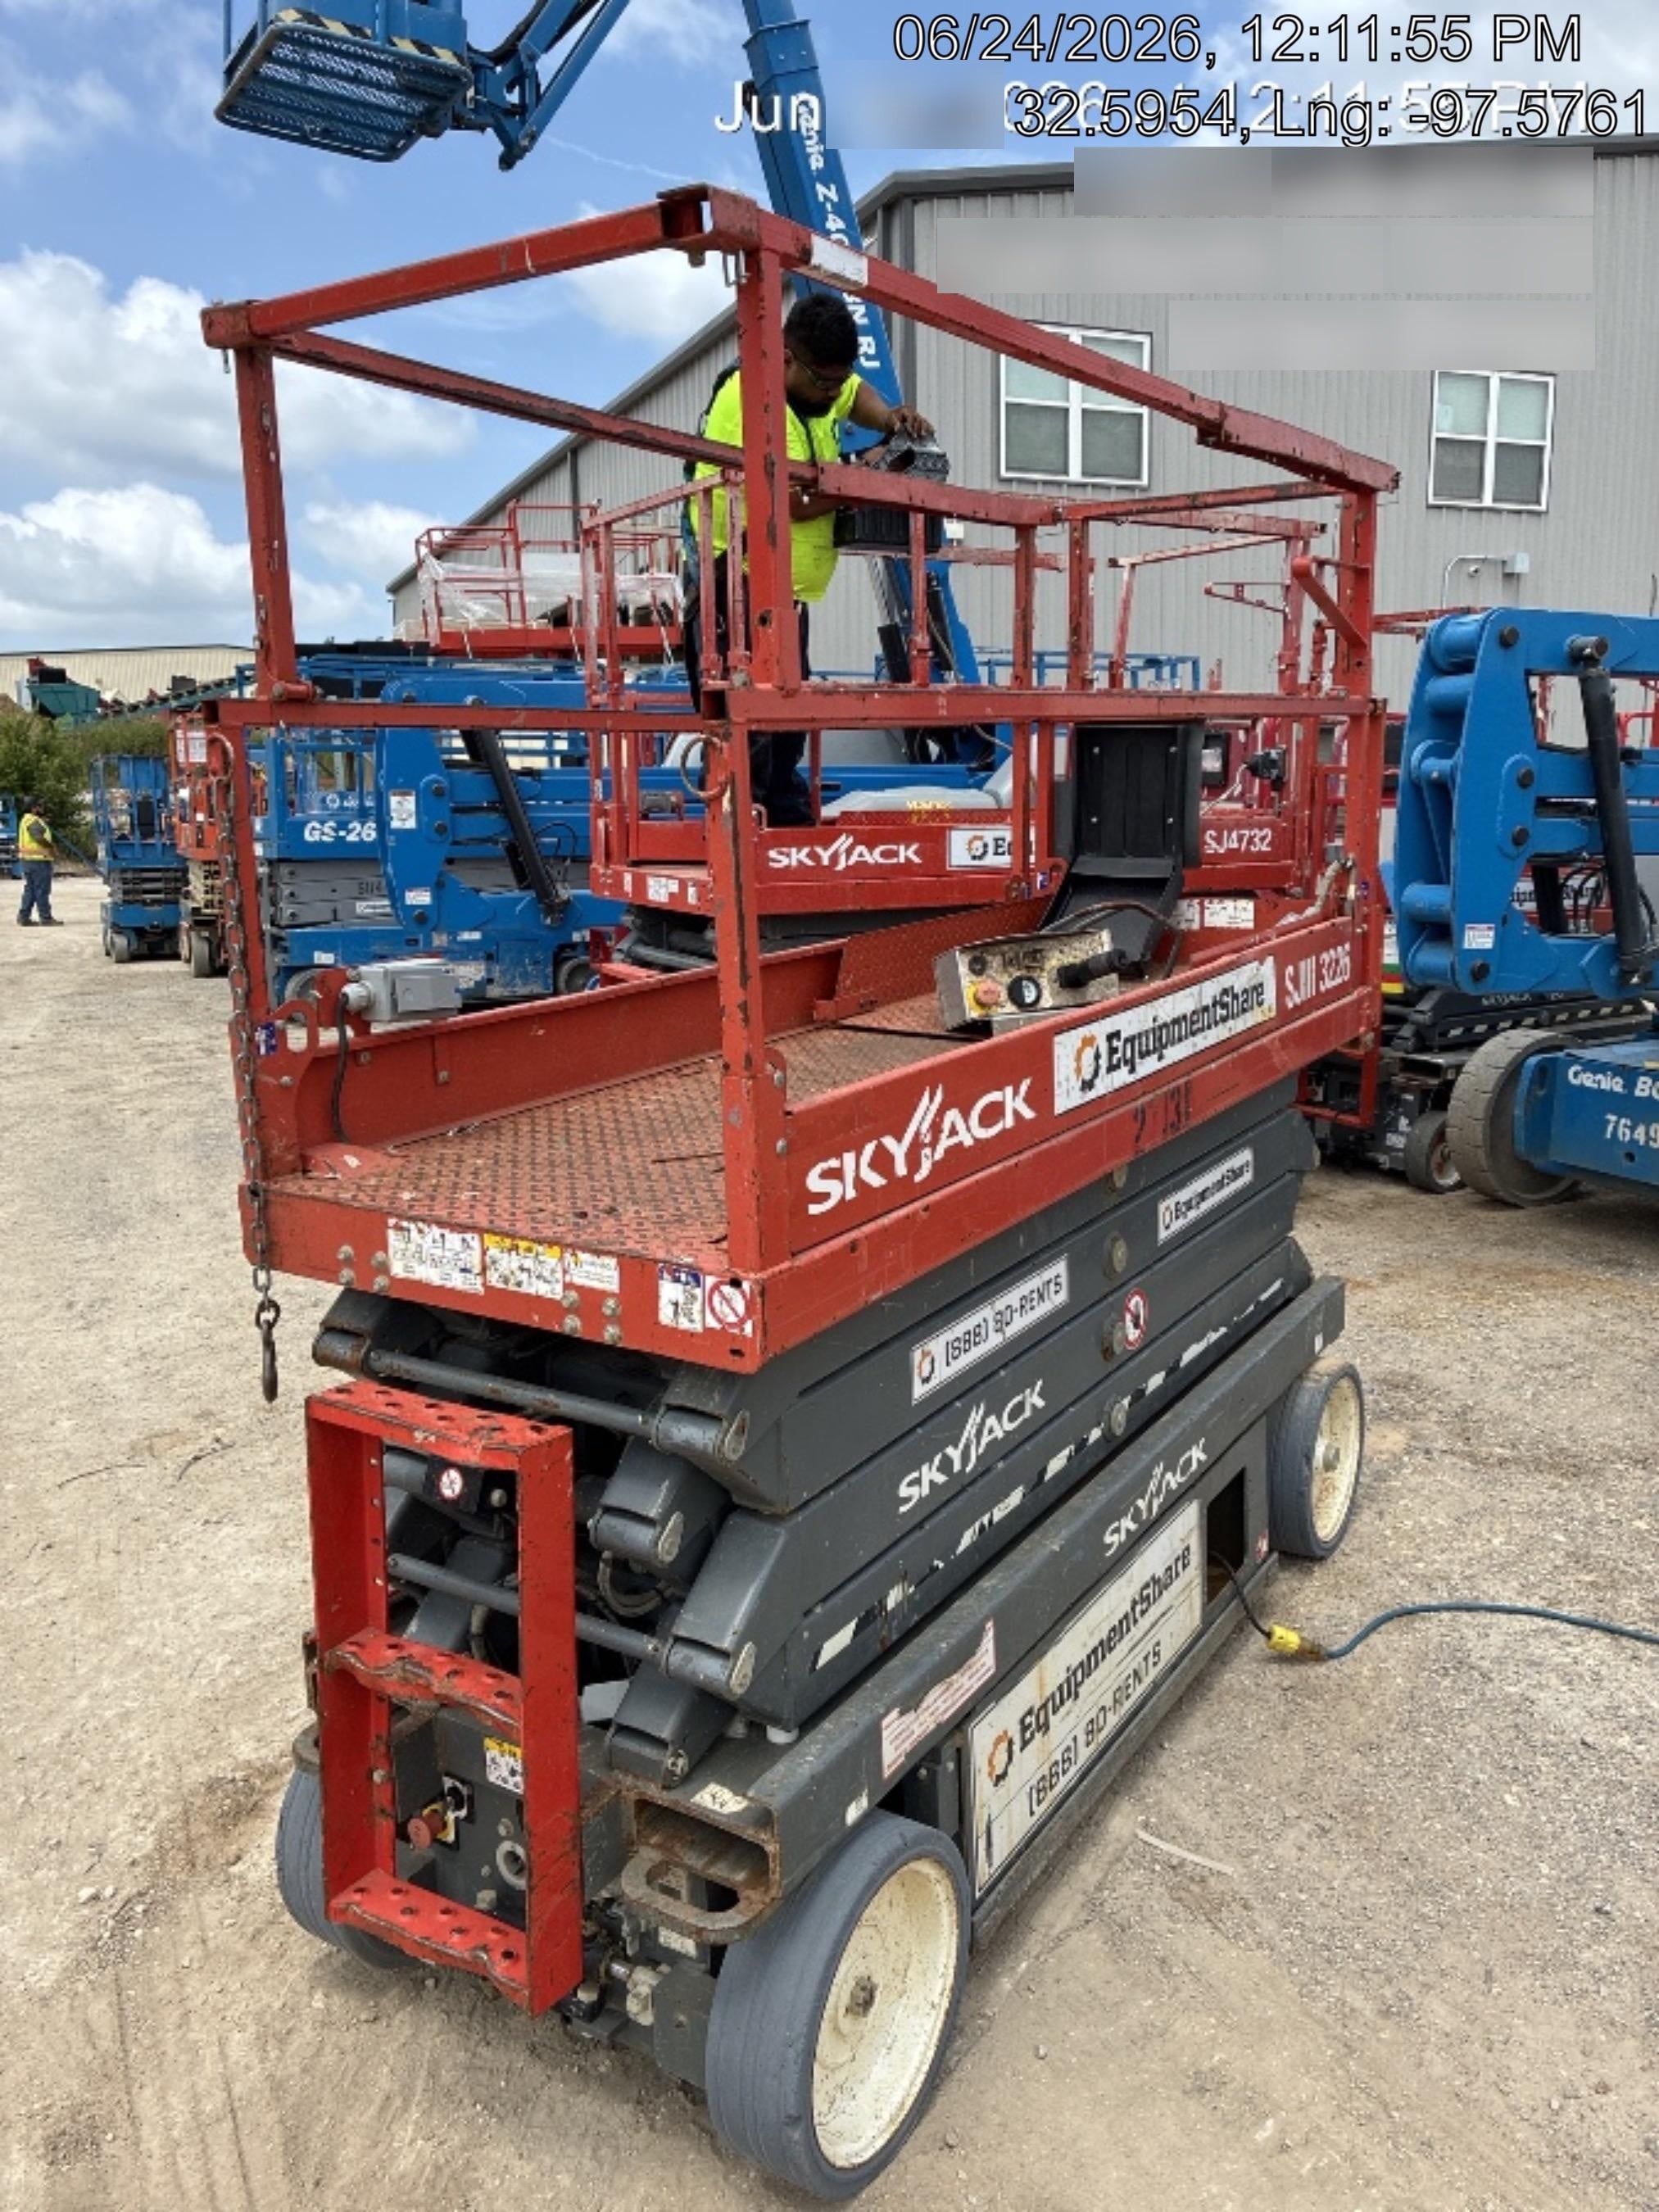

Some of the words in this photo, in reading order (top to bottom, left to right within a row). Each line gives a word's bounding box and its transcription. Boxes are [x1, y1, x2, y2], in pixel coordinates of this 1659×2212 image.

[768, 832, 922, 871] SKYJACK
[1203, 827, 1272, 854] SJ4732
[1106, 982, 1266, 1076] EquipmentShare
[805, 1077, 1037, 1216] SKYJACK
[994, 1271, 1063, 1335] 80-RENTS
[897, 1378, 1047, 1514] SKYJACK
[1103, 1436, 1208, 1557] SKYJACK
[1018, 1543, 1190, 1753] EquipmentShare
[1084, 1641, 1162, 1751] 80-RENTS
